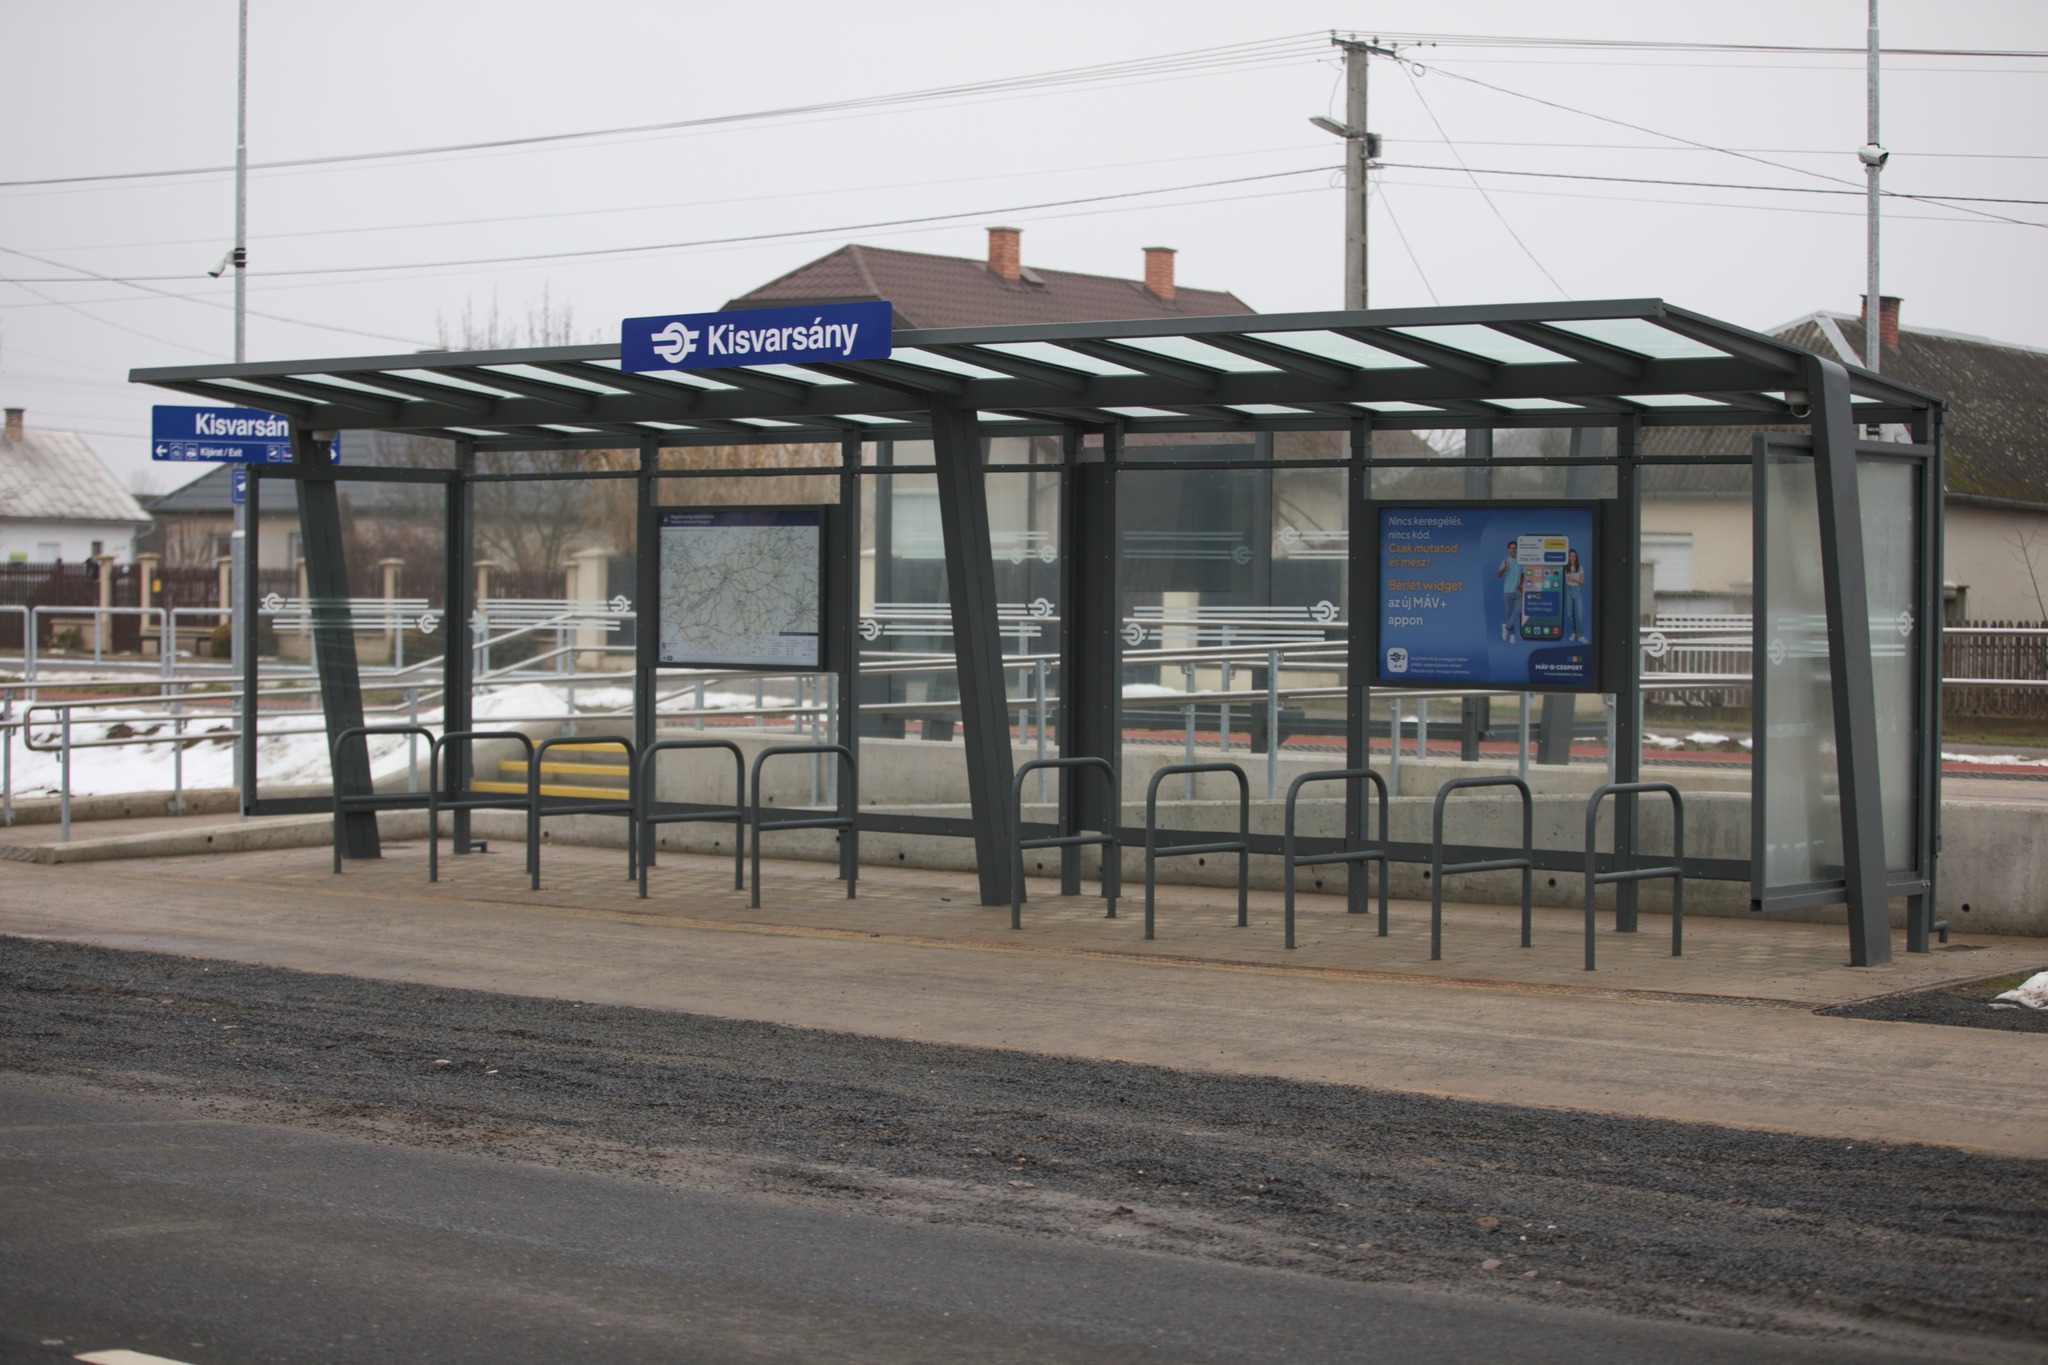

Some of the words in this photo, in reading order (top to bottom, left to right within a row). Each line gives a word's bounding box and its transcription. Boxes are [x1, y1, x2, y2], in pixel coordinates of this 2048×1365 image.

[708, 316, 859, 356] Kisvarsány
[195, 412, 289, 437] Kisvarsán
[1388, 516, 1412, 526] Nincs
[1388, 530, 1412, 540] nincs
[1388, 543, 1412, 553] Csak
[1388, 557, 1399, 567] és
[1401, 557, 1430, 567] mész!
[1388, 579, 1421, 591] Bérlet
[1423, 580, 1463, 594] widget
[1388, 599, 1400, 608] az
[1401, 596, 1412, 610] új
[1413, 593, 1447, 609] MÁV+
[1388, 616, 1423, 628] appon
